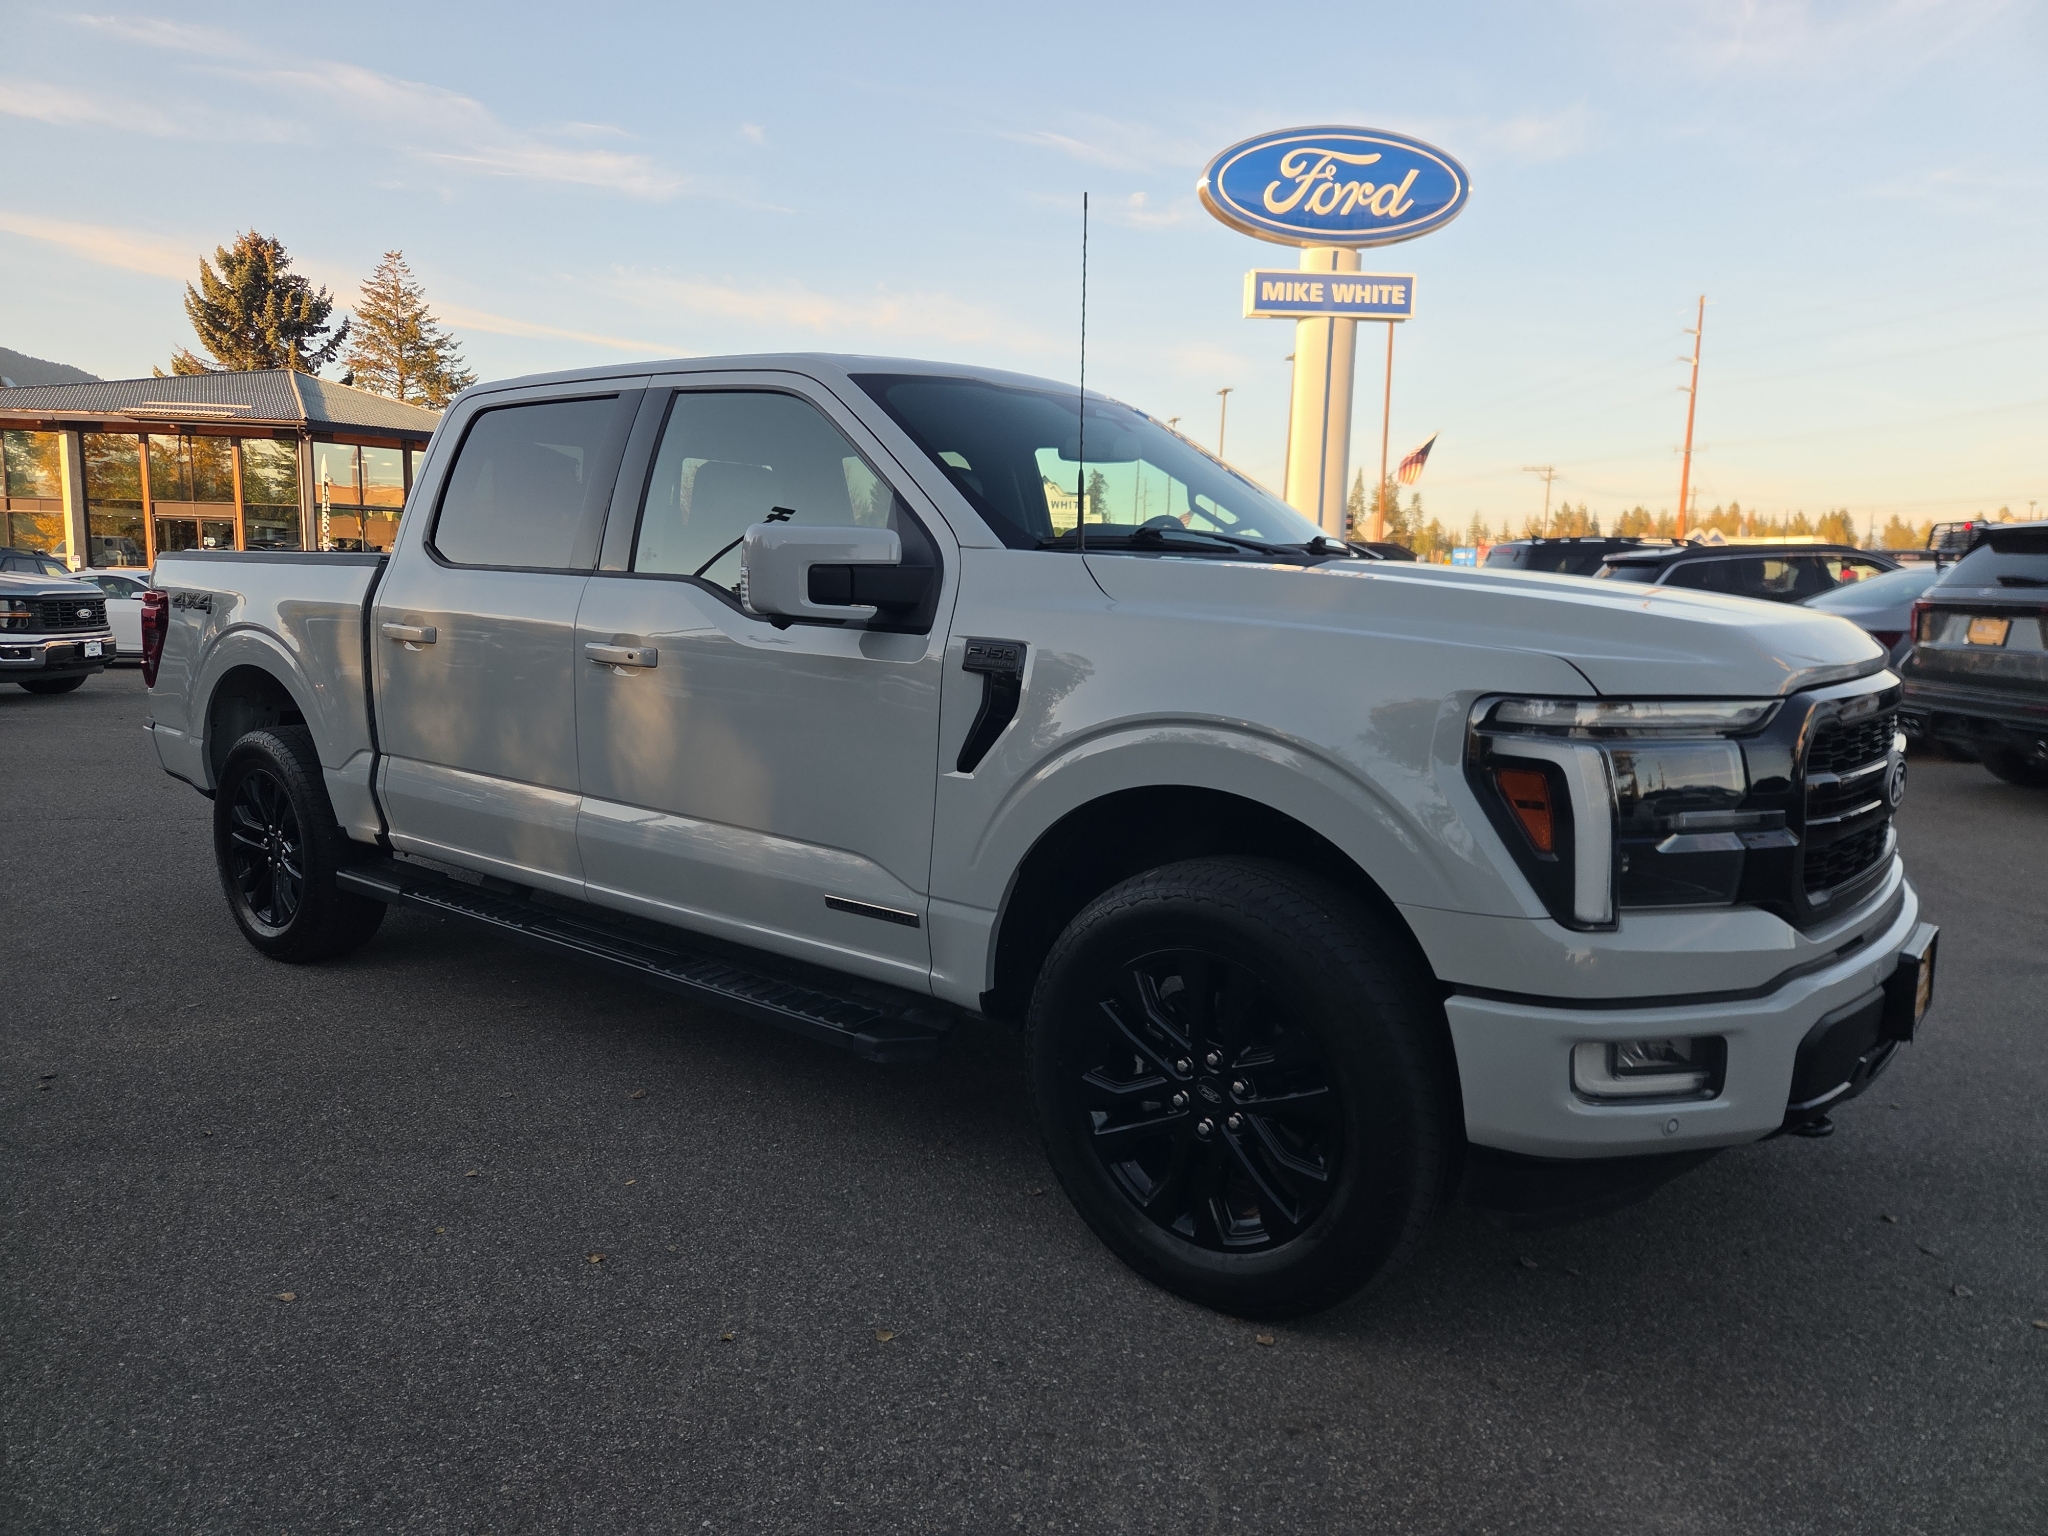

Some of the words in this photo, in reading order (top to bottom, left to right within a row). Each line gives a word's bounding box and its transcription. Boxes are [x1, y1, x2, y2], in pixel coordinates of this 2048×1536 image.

[1264, 147, 1420, 217] Ford
[1262, 281, 1324, 303] MIKE
[1332, 283, 1406, 305] WHITE
